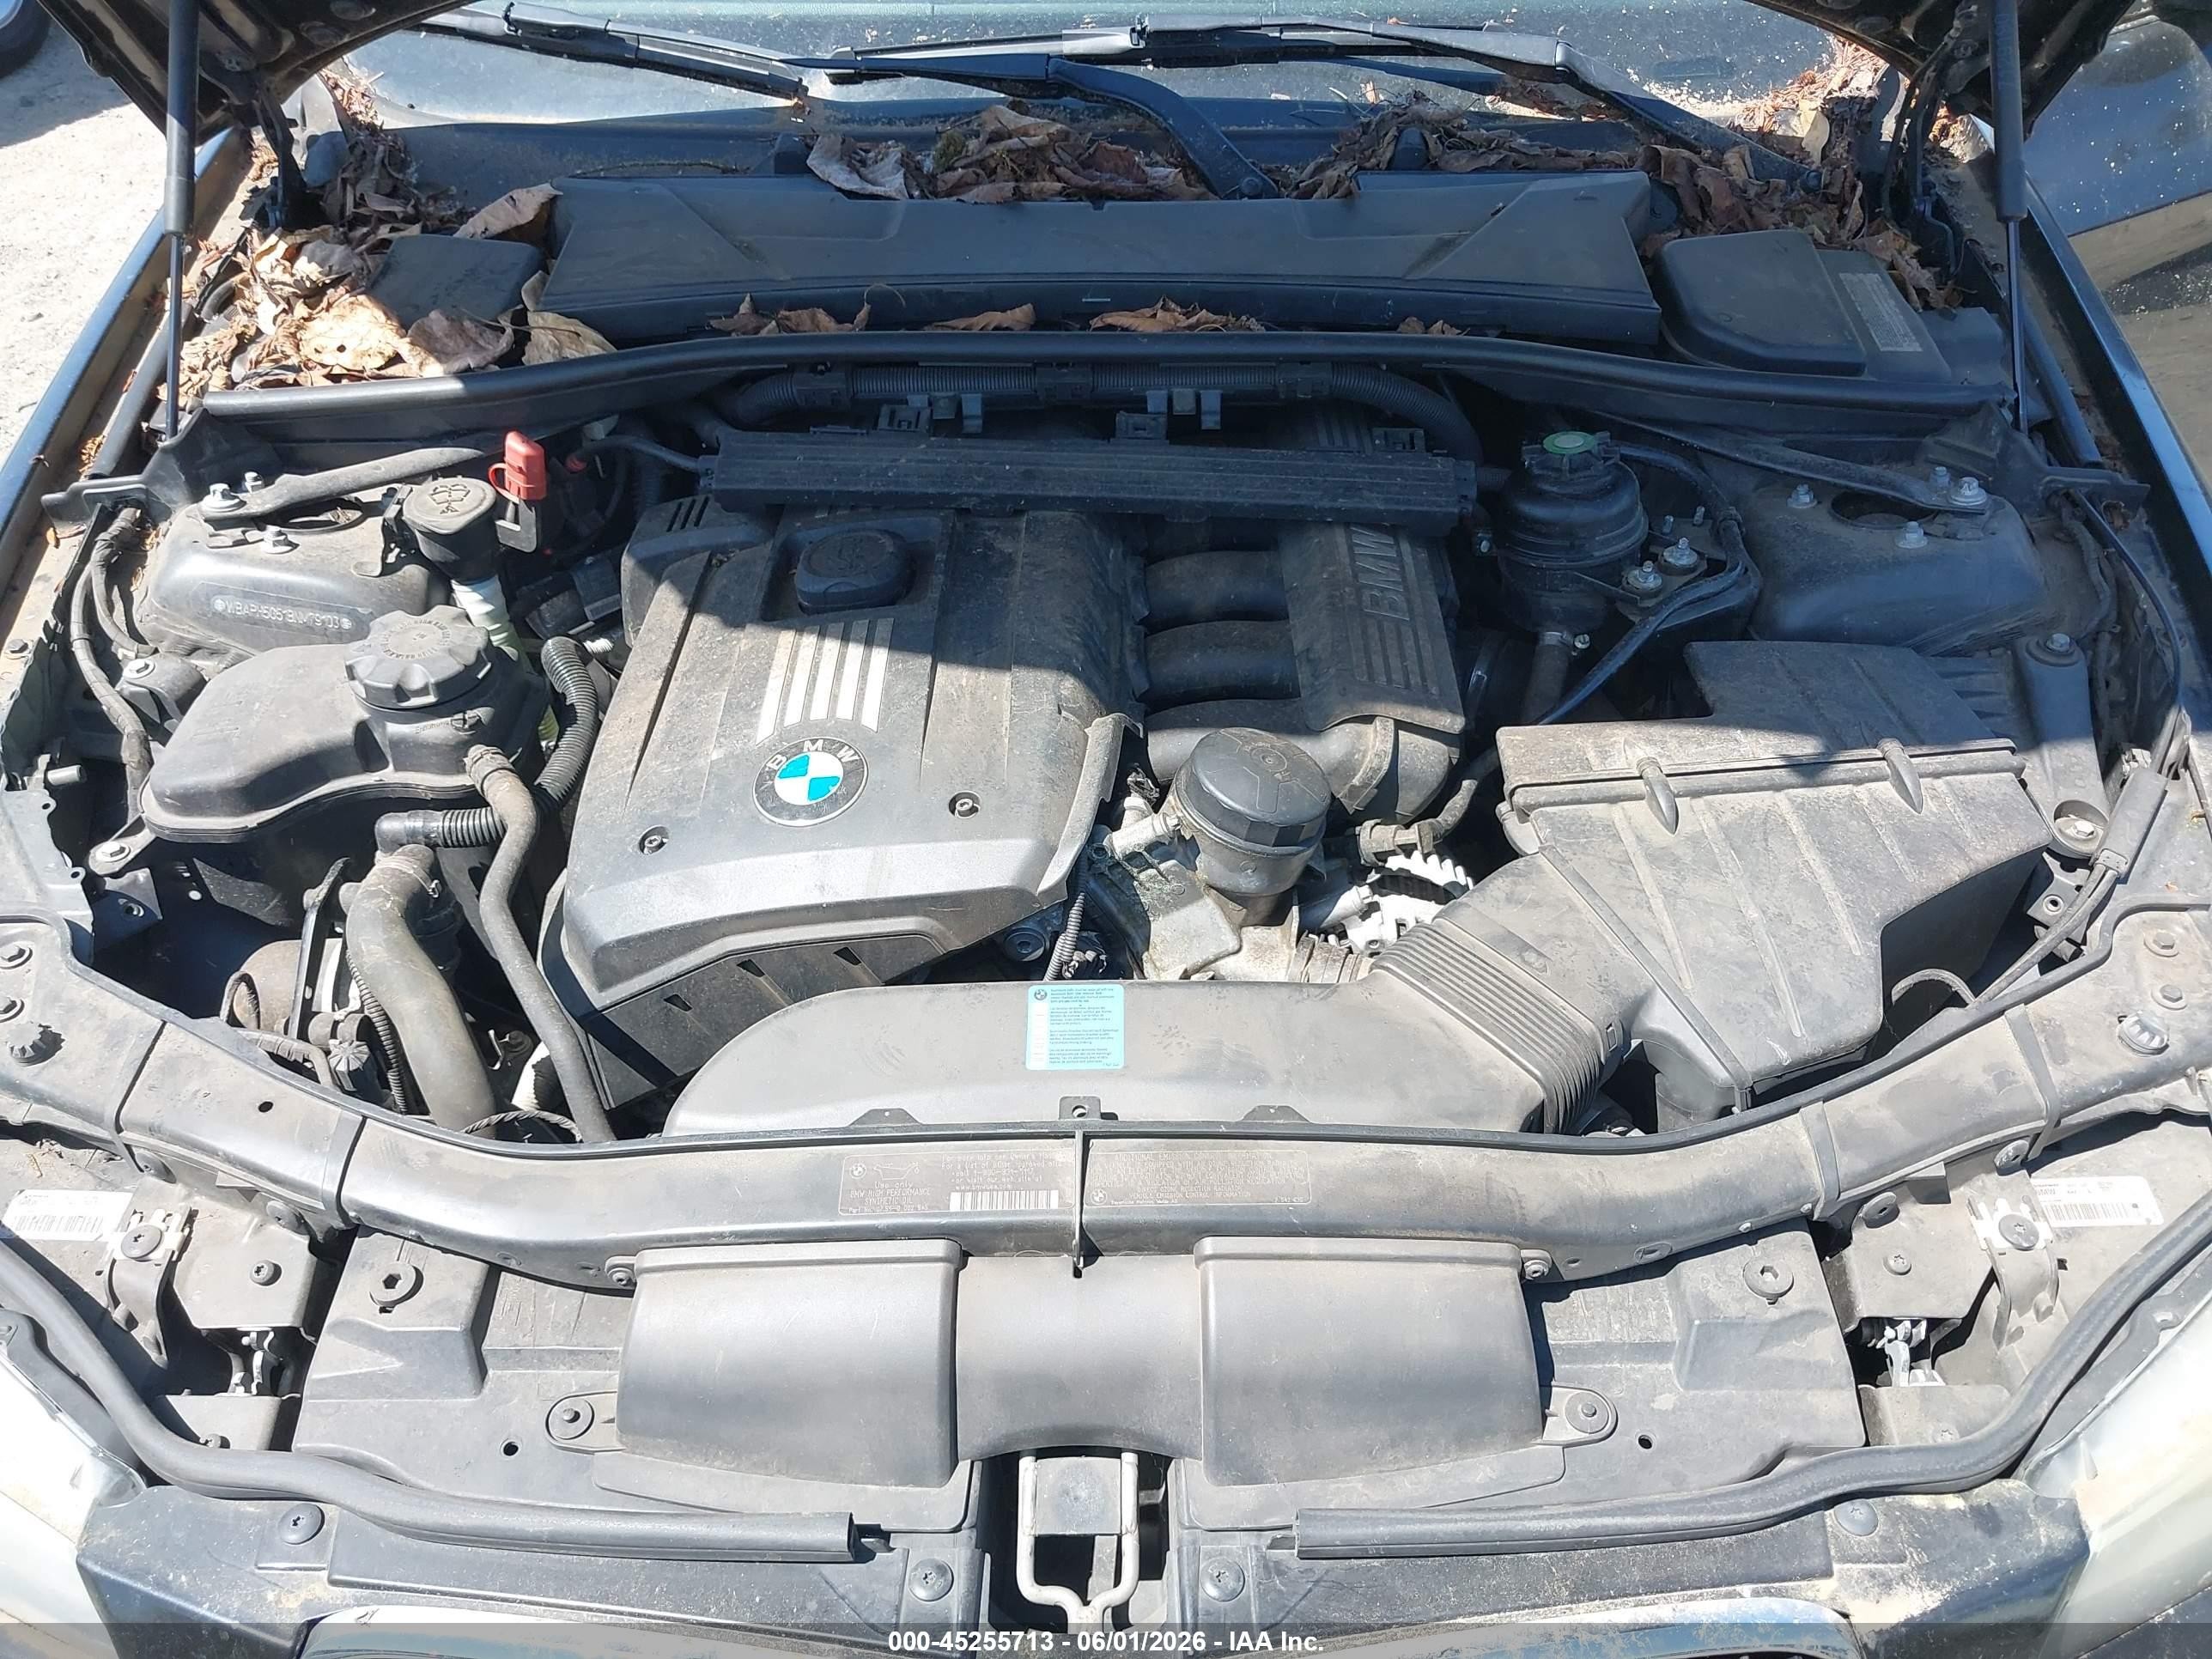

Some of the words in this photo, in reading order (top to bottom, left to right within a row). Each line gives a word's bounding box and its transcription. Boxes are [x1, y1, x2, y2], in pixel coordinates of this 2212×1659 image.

[765, 738, 860, 770] BMW
[874, 1181, 888, 1189] Use
[896, 1180, 914, 1189] only
[850, 1189, 865, 1199] BMW
[867, 1189, 884, 1198] HIGH
[886, 1187, 931, 1198] PERFORMANCE
[864, 1196, 898, 1206] SYNTHETIC
[902, 1196, 913, 1205] OIL
